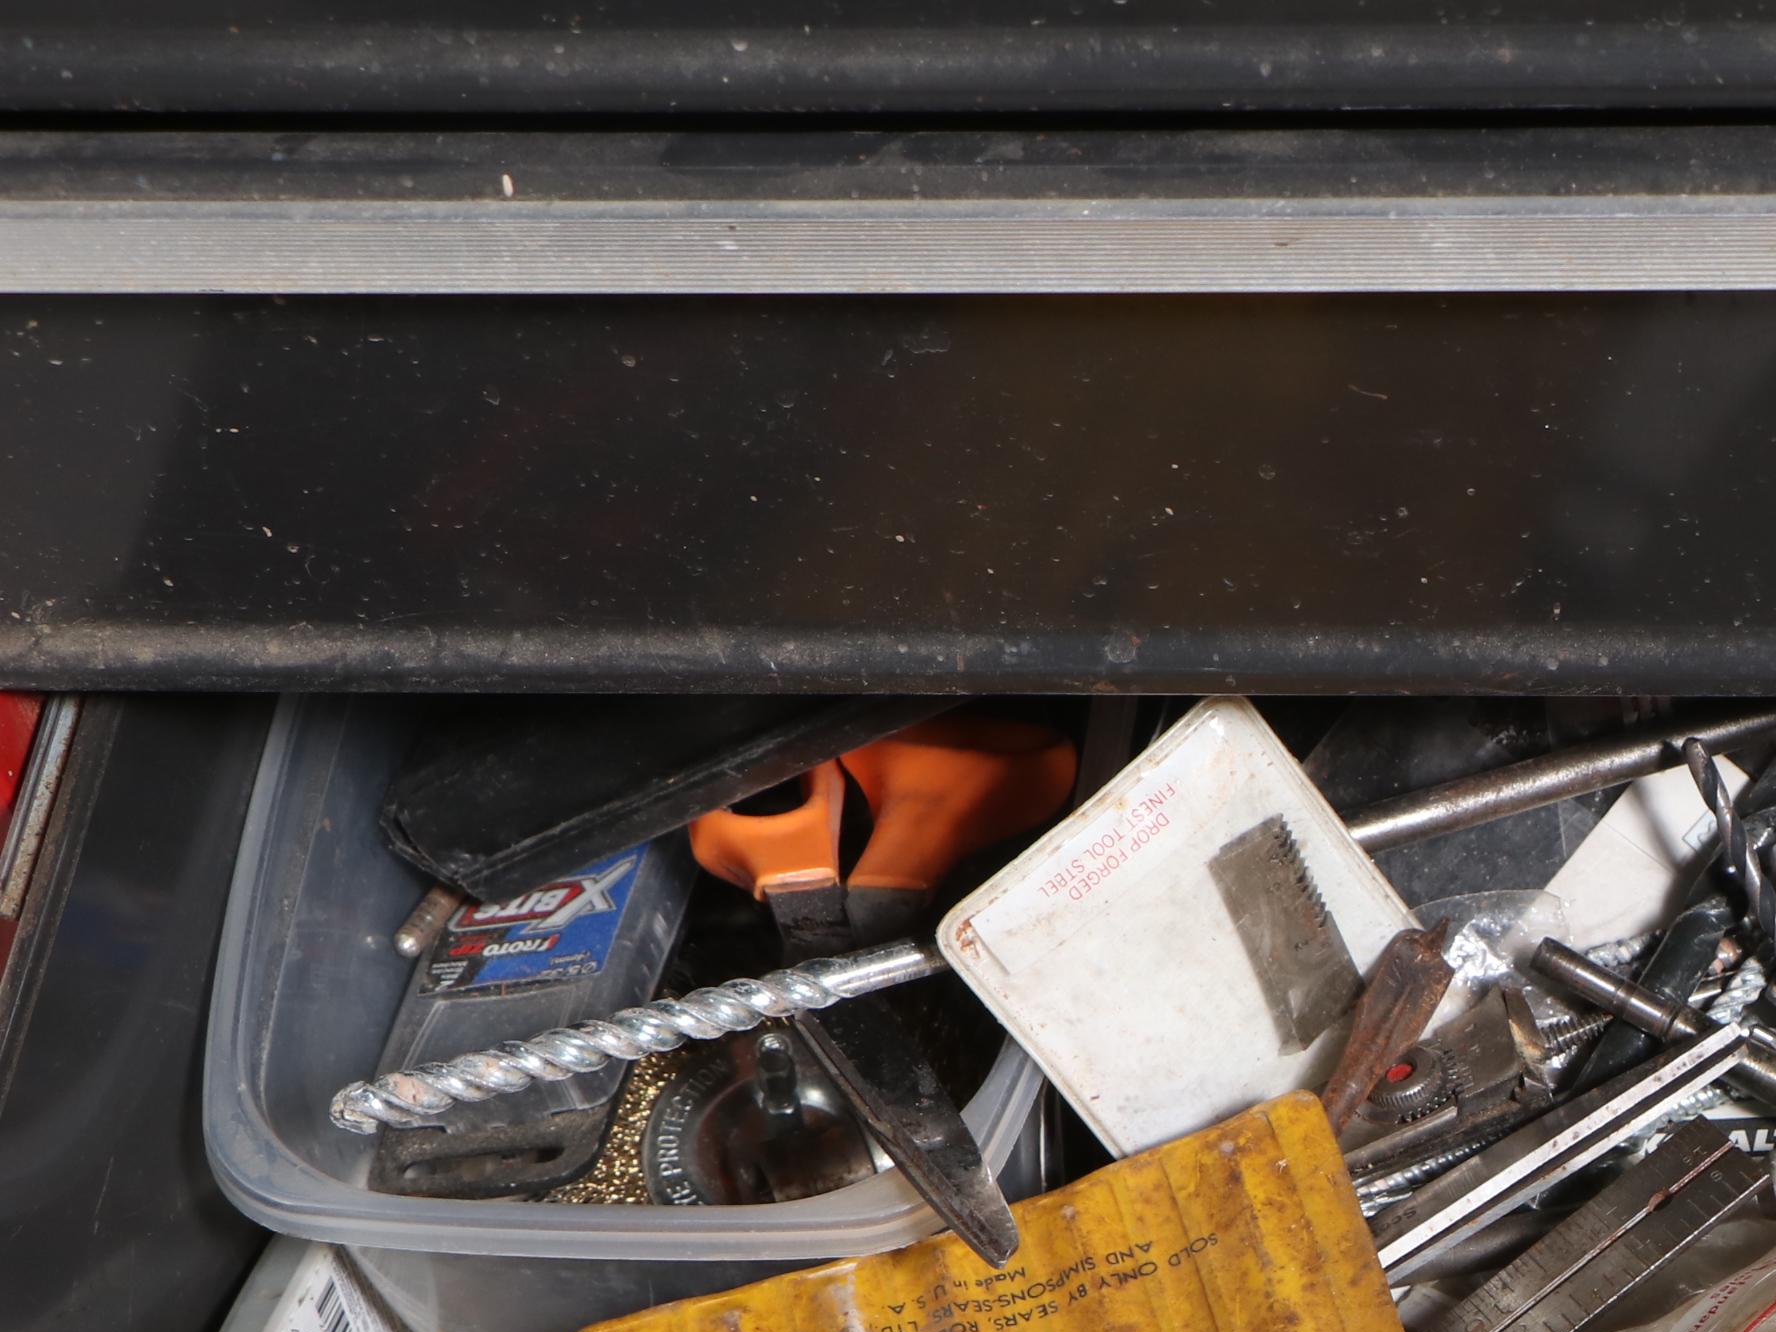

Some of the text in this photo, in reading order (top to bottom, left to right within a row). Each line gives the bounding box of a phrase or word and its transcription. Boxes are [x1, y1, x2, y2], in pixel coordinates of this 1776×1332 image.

[1120, 781, 1177, 831] FINEST
[1065, 810, 1171, 903] DROP FORGED
[1082, 825, 1125, 864] TOOL
[661, 1060, 735, 1184] PROTECTION
[1105, 1240, 1152, 1265] AND
[1167, 1232, 1217, 1267] SOLD
[952, 1278, 967, 1290] in
[973, 1266, 1025, 1289] Made
[1097, 1261, 1157, 1289] ONLY
[1067, 1283, 1087, 1302] BY
[986, 1298, 1057, 1331] SEARS,
